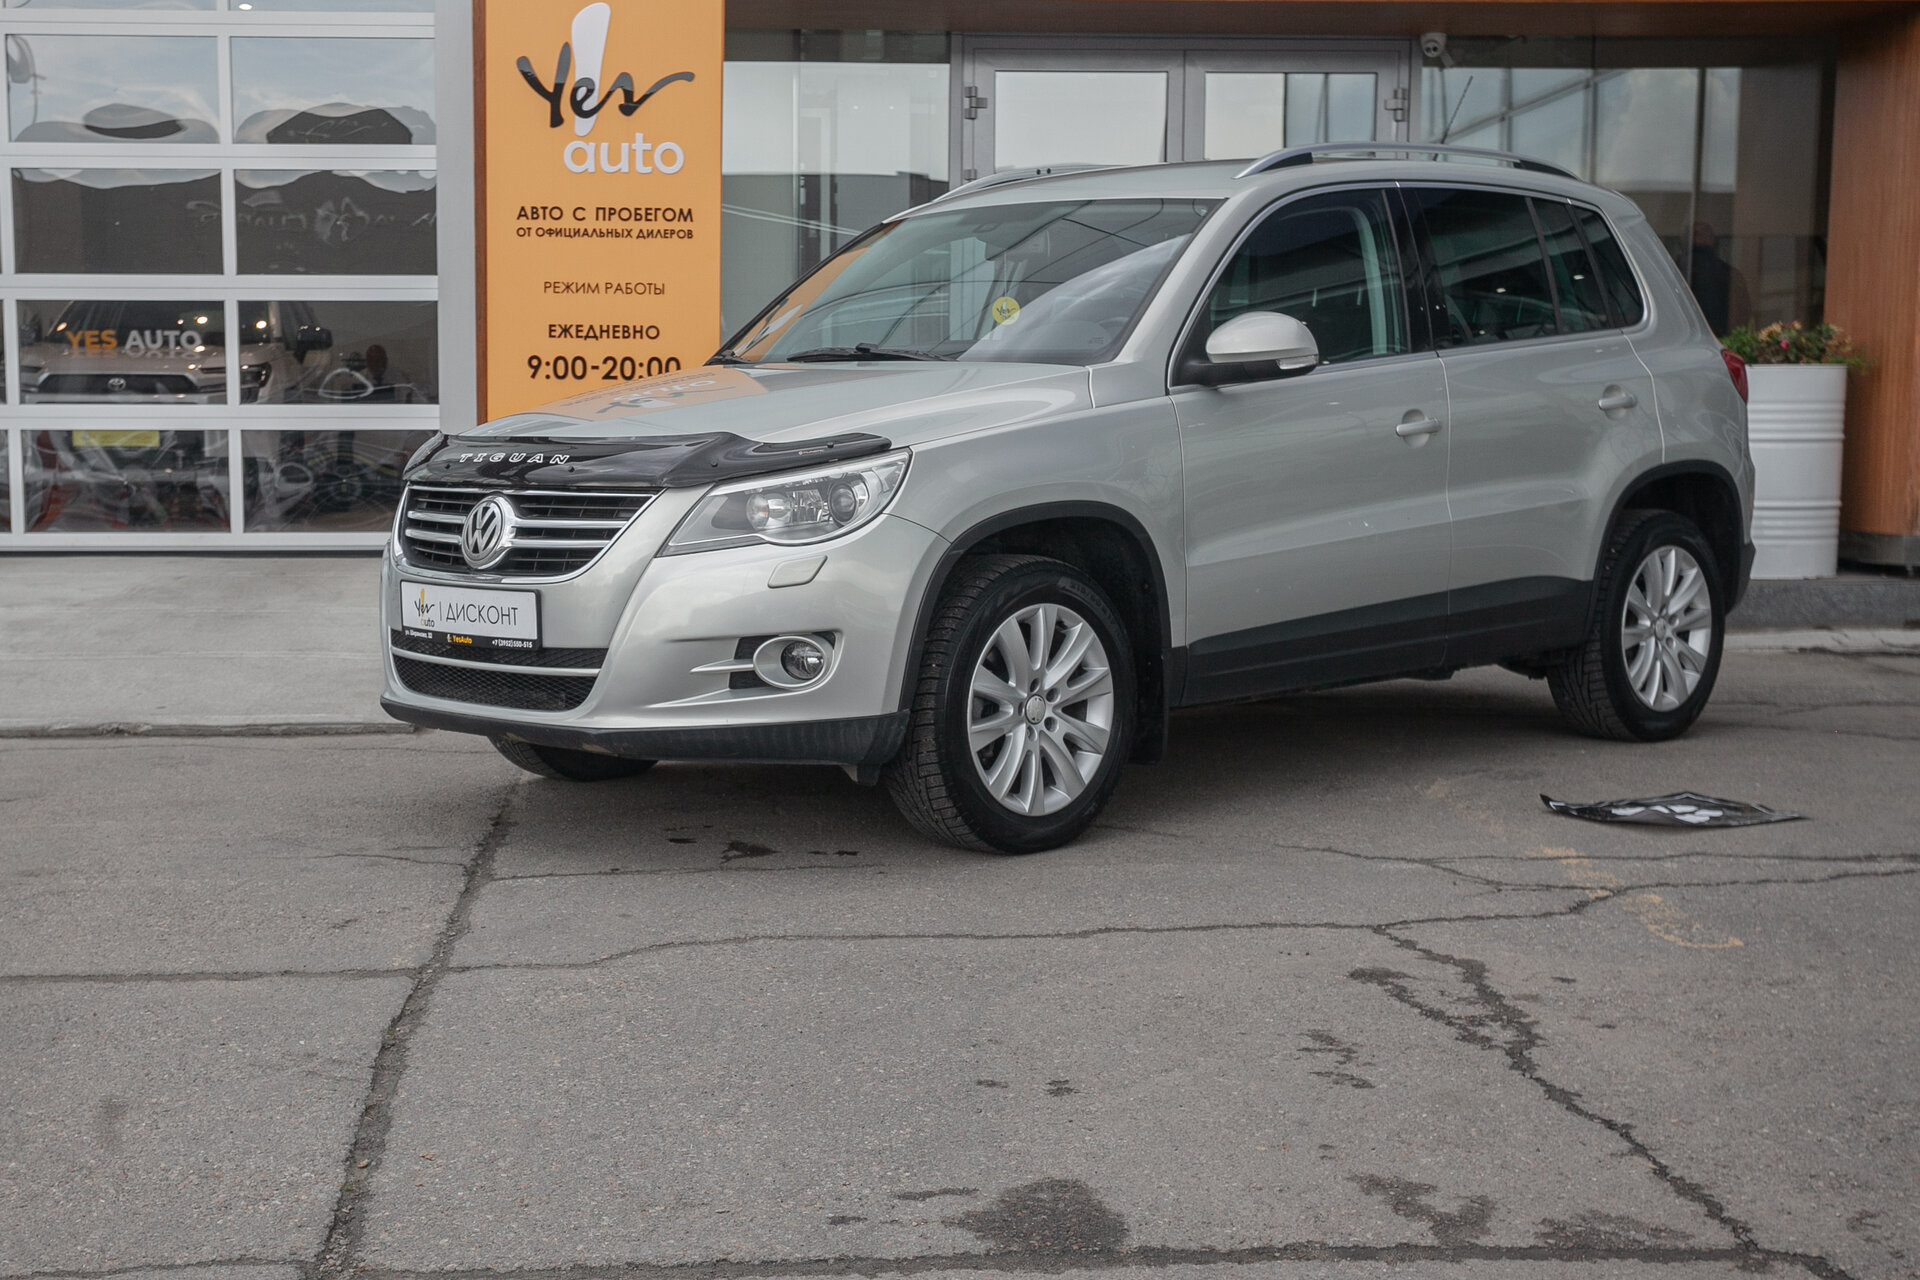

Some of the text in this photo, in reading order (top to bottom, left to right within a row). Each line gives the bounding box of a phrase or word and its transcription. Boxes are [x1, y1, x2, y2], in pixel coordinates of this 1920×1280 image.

[563, 132, 684, 174] auto
[516, 206, 694, 222] АВТО С ПРОБЕГОМ
[516, 227, 694, 240] ОТ ОФИЦИАЛЬНЫХ ДИЛЕРОВ
[543, 281, 665, 295] РЕЖИМ РАБОТЫ
[65, 330, 202, 350] YES AUTO
[548, 324, 661, 341] ЕЖЕДНЕВНО
[527, 355, 682, 380] 9:00-20:00
[459, 453, 570, 464] TIGUAN
[446, 602, 519, 626] ДИСКОНТ
